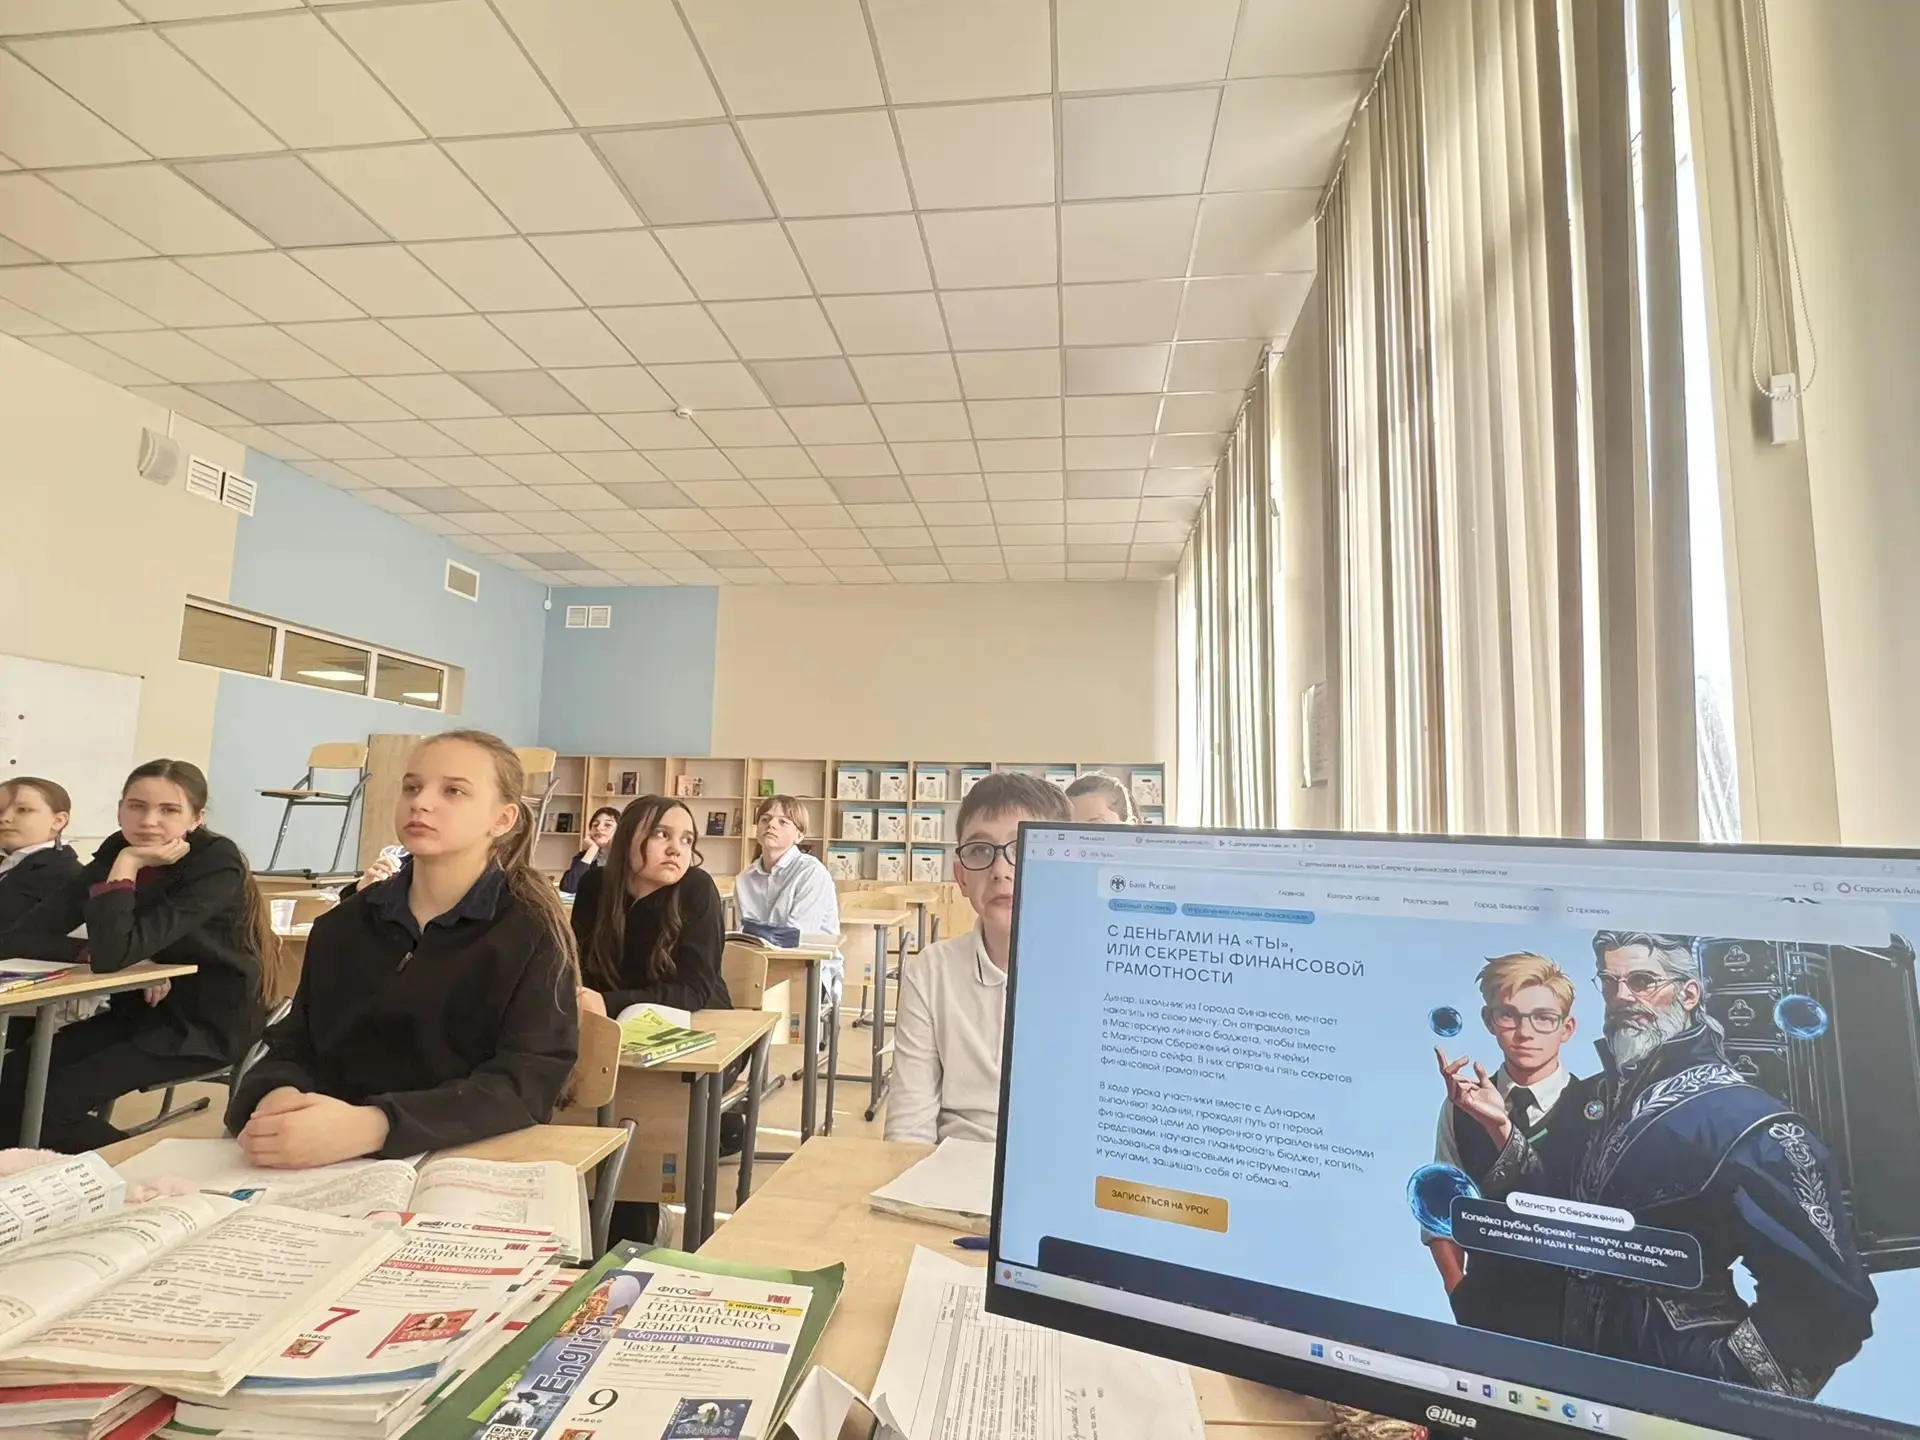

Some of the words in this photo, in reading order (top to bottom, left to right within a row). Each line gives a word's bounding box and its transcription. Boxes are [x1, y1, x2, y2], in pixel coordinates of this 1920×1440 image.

[1129, 880, 1146, 889] Банк
[1149, 882, 1176, 891] России
[1854, 884, 1901, 894] Спросить
[1108, 924, 1118, 937] С
[1123, 926, 1213, 945] ДЕНЬГАМИ
[1218, 933, 1240, 946] НА
[1246, 936, 1293, 953] «ТЫ»,
[1106, 961, 1233, 984] ГРАМОТНОСТИ
[1107, 942, 1139, 957] ИЛИ
[1145, 945, 1224, 964] СЕКРЕТЫ
[1229, 952, 1364, 977] ФИНАНСОВОЙ
[1104, 992, 1136, 1004] Динар,
[1139, 997, 1183, 1009] школьник
[1185, 1002, 1196, 1010] из
[1199, 1002, 1235, 1014] Города
[1237, 1006, 1292, 1021] Финансов,
[1295, 1015, 1337, 1025] мечтает
[1104, 1006, 1145, 1017] накопить
[1161, 1013, 1187, 1022] свою
[1189, 1016, 1220, 1027] мечту.
[1222, 1018, 1237, 1028] Он
[1240, 1021, 1310, 1036] отправляется
[1110, 1018, 1170, 1034] Мастерскую
[1172, 1028, 1211, 1038] личного
[1213, 1030, 1261, 1045] бюджета,
[1264, 1038, 1294, 1048] чтобы
[1297, 1042, 1336, 1053] вместе
[1111, 1031, 1162, 1045] Магистром
[1165, 1038, 1230, 1054] Сбережений
[1232, 1047, 1271, 1059] открыть
[1274, 1052, 1310, 1064] ячейки
[1101, 1044, 1158, 1057] волшебного
[1198, 1055, 1203, 1064] В
[1206, 1058, 1223, 1066] них
[1225, 1060, 1274, 1073] спрятаны
[1277, 1066, 1298, 1076] пять
[1301, 1070, 1352, 1083] секретов
[1101, 1056, 1160, 1071] финансовой
[1162, 1066, 1227, 1080] грамотности.
[1100, 1081, 1105, 1089] В
[1107, 1084, 1129, 1093] ходе
[1132, 1087, 1160, 1098] урока
[1163, 1092, 1212, 1105] участники
[1215, 1100, 1252, 1112] вместе
[1264, 1105, 1315, 1120] Динаром
[1099, 1095, 1148, 1109] выполняют
[1151, 1103, 1194, 1117] задания,
[1196, 1110, 1242, 1121] проходят
[1245, 1117, 1266, 1128] путь
[1269, 1122, 1280, 1130] от
[1283, 1123, 1323, 1136] первой
[1098, 1107, 1158, 1124] финансовой
[1160, 1118, 1184, 1128] цели
[1186, 1122, 1199, 1131] до
[1202, 1125, 1262, 1141] уверенного
[1265, 1135, 1329, 1151] управления
[1331, 1145, 1375, 1159] своими
[1097, 1134, 1160, 1151] пользоваться
[1162, 1145, 1234, 1164] финансовыми
[1236, 1157, 1320, 1179] инструментами
[1160, 1132, 1205, 1145] научатся
[1208, 1140, 1274, 1157] планировать
[1277, 1149, 1322, 1166] бюджет,
[1324, 1159, 1364, 1172] копить,
[1104, 1149, 1150, 1164] услугами,
[1152, 1158, 1202, 1173] защищать
[1204, 1167, 1229, 1177] себя
[1232, 1172, 1242, 1180] от
[1246, 1173, 1292, 1188] обмана.
[1112, 1189, 1169, 1207] ЗАПИСАТЬСЯ
[1171, 1201, 1183, 1210] НА
[1185, 1204, 1209, 1215] УРОК
[1515, 1199, 1556, 1213] Магистр
[1558, 1206, 1624, 1224] Сбережений
[406, 1240, 497, 1254] РАММАТИКА
[1461, 1211, 1501, 1226] Копейка
[1503, 1220, 1532, 1231] рубль
[1533, 1224, 1576, 1238] бережёт
[1590, 1235, 1622, 1248] научу,
[1624, 1241, 1642, 1250] как
[1644, 1245, 1688, 1258] дружить
[394, 1254, 436, 1263] ЗЫКА
[401, 1248, 503, 1261] НГЛИЙСКОГО
[1488, 1229, 1533, 1244] деньгами
[1544, 1239, 1566, 1249] идти
[1576, 1245, 1605, 1256] мечте
[1607, 1249, 1626, 1260] без
[1628, 1254, 1668, 1267] потерь.
[658, 1286, 697, 1296] ФГОС
[767, 1294, 791, 1304] УМК
[314, 1307, 360, 1332] 7
[640, 1312, 780, 1332] АНГЛИЙСКОГО
[647, 1302, 771, 1321] ГРАММАТИКА
[634, 1321, 699, 1332] ЯЗЫКА
[623, 1341, 664, 1351] Часть
[627, 1330, 686, 1342] сборник
[688, 1334, 775, 1350] упражнений
[529, 1315, 620, 1395] English
[1349, 1354, 1371, 1366] Поиск
[579, 1388, 618, 1415] 9
